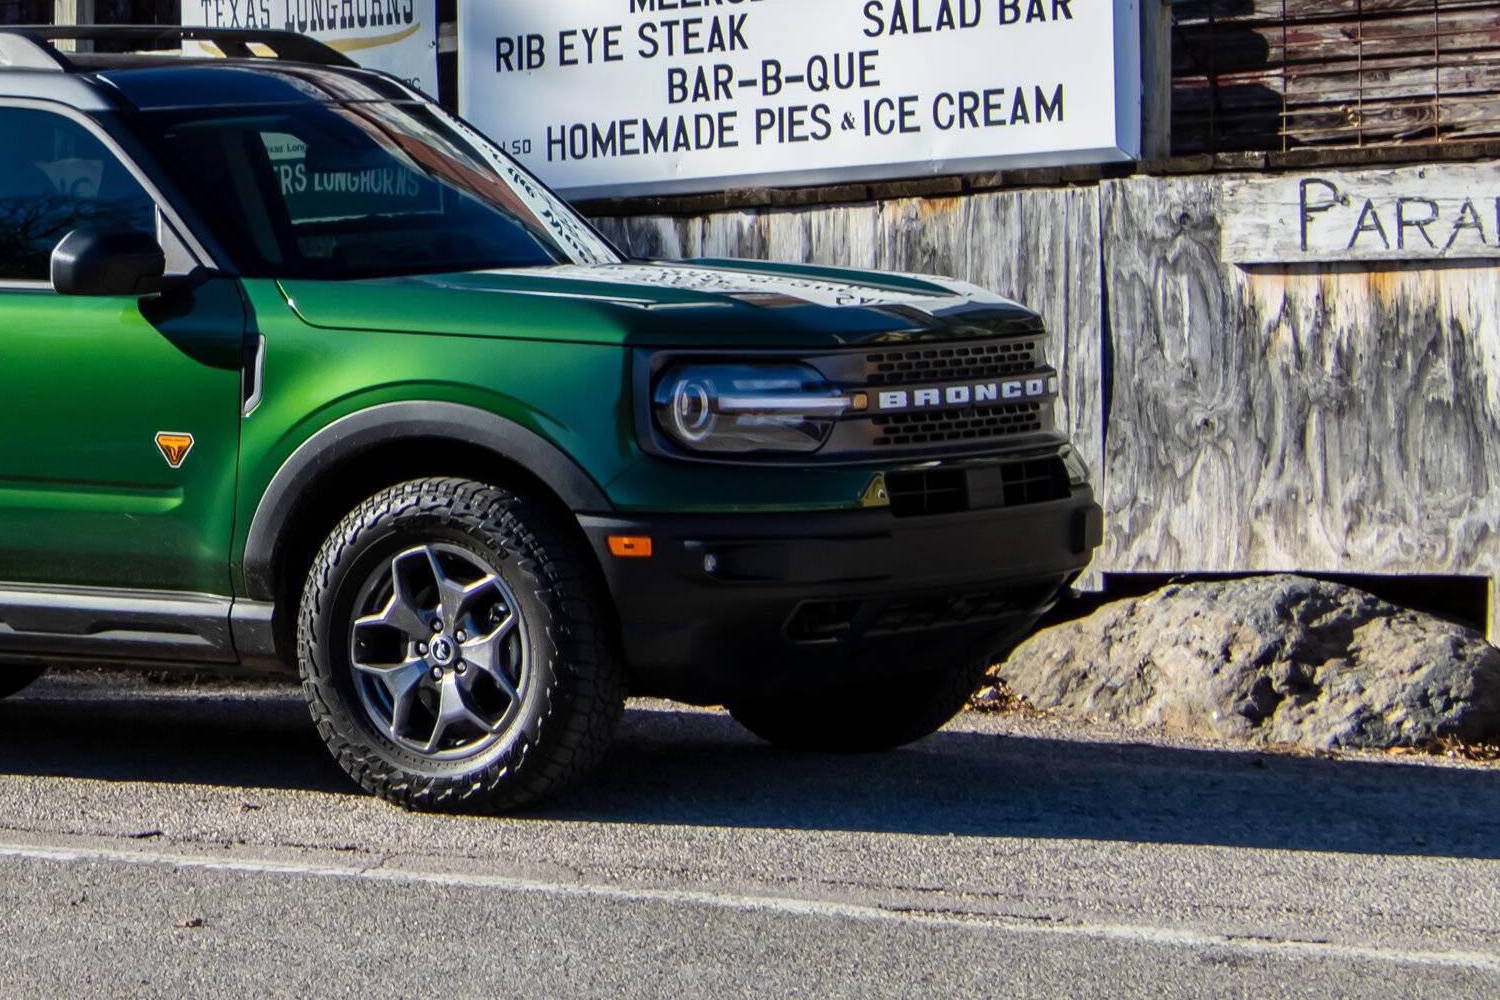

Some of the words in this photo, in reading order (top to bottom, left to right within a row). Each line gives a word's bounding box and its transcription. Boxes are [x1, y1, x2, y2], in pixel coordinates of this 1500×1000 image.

[495, 34, 546, 73] RIB
[559, 25, 624, 67] EYE
[638, 13, 749, 60] STEAK
[667, 50, 881, 105] BAR-B-QUE
[547, 111, 739, 163] HOMEMADE
[755, 102, 832, 146] PIES
[841, 111, 856, 131] &
[863, 96, 921, 137] ICE
[932, 83, 1064, 132] CREAM
[1299, 177, 1500, 257] PARA
[878, 378, 1044, 409] BRONCO
